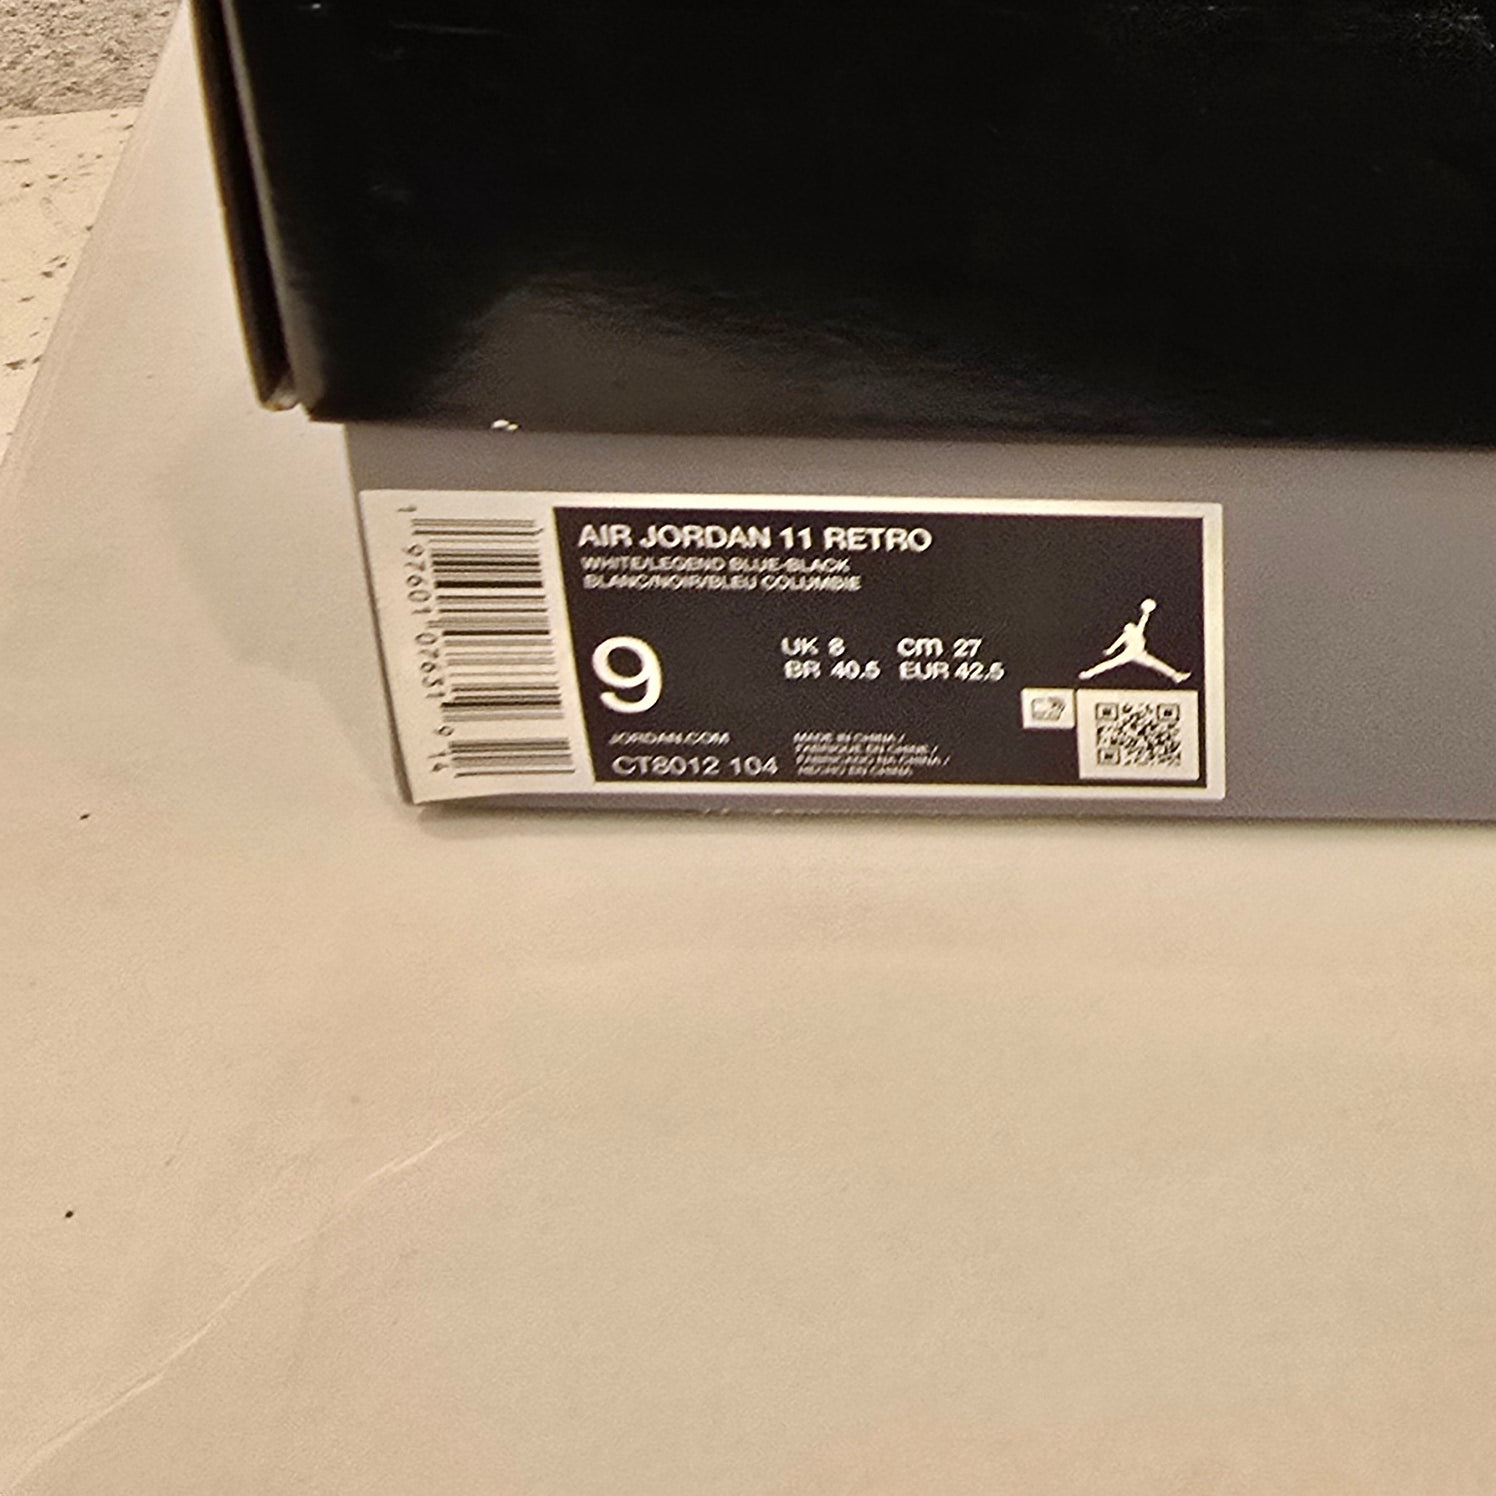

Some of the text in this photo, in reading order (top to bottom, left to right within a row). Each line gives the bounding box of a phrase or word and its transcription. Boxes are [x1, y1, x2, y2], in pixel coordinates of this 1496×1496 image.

[578, 523, 933, 553] AIR JORDAN 11 RETRO
[781, 636, 819, 656] UK
[896, 637, 944, 657] cm
[952, 638, 983, 658] 27
[591, 635, 663, 714] 9
[784, 659, 1005, 682] BR 40.5 EUR 42.5
[611, 754, 779, 777] CT8012 104
